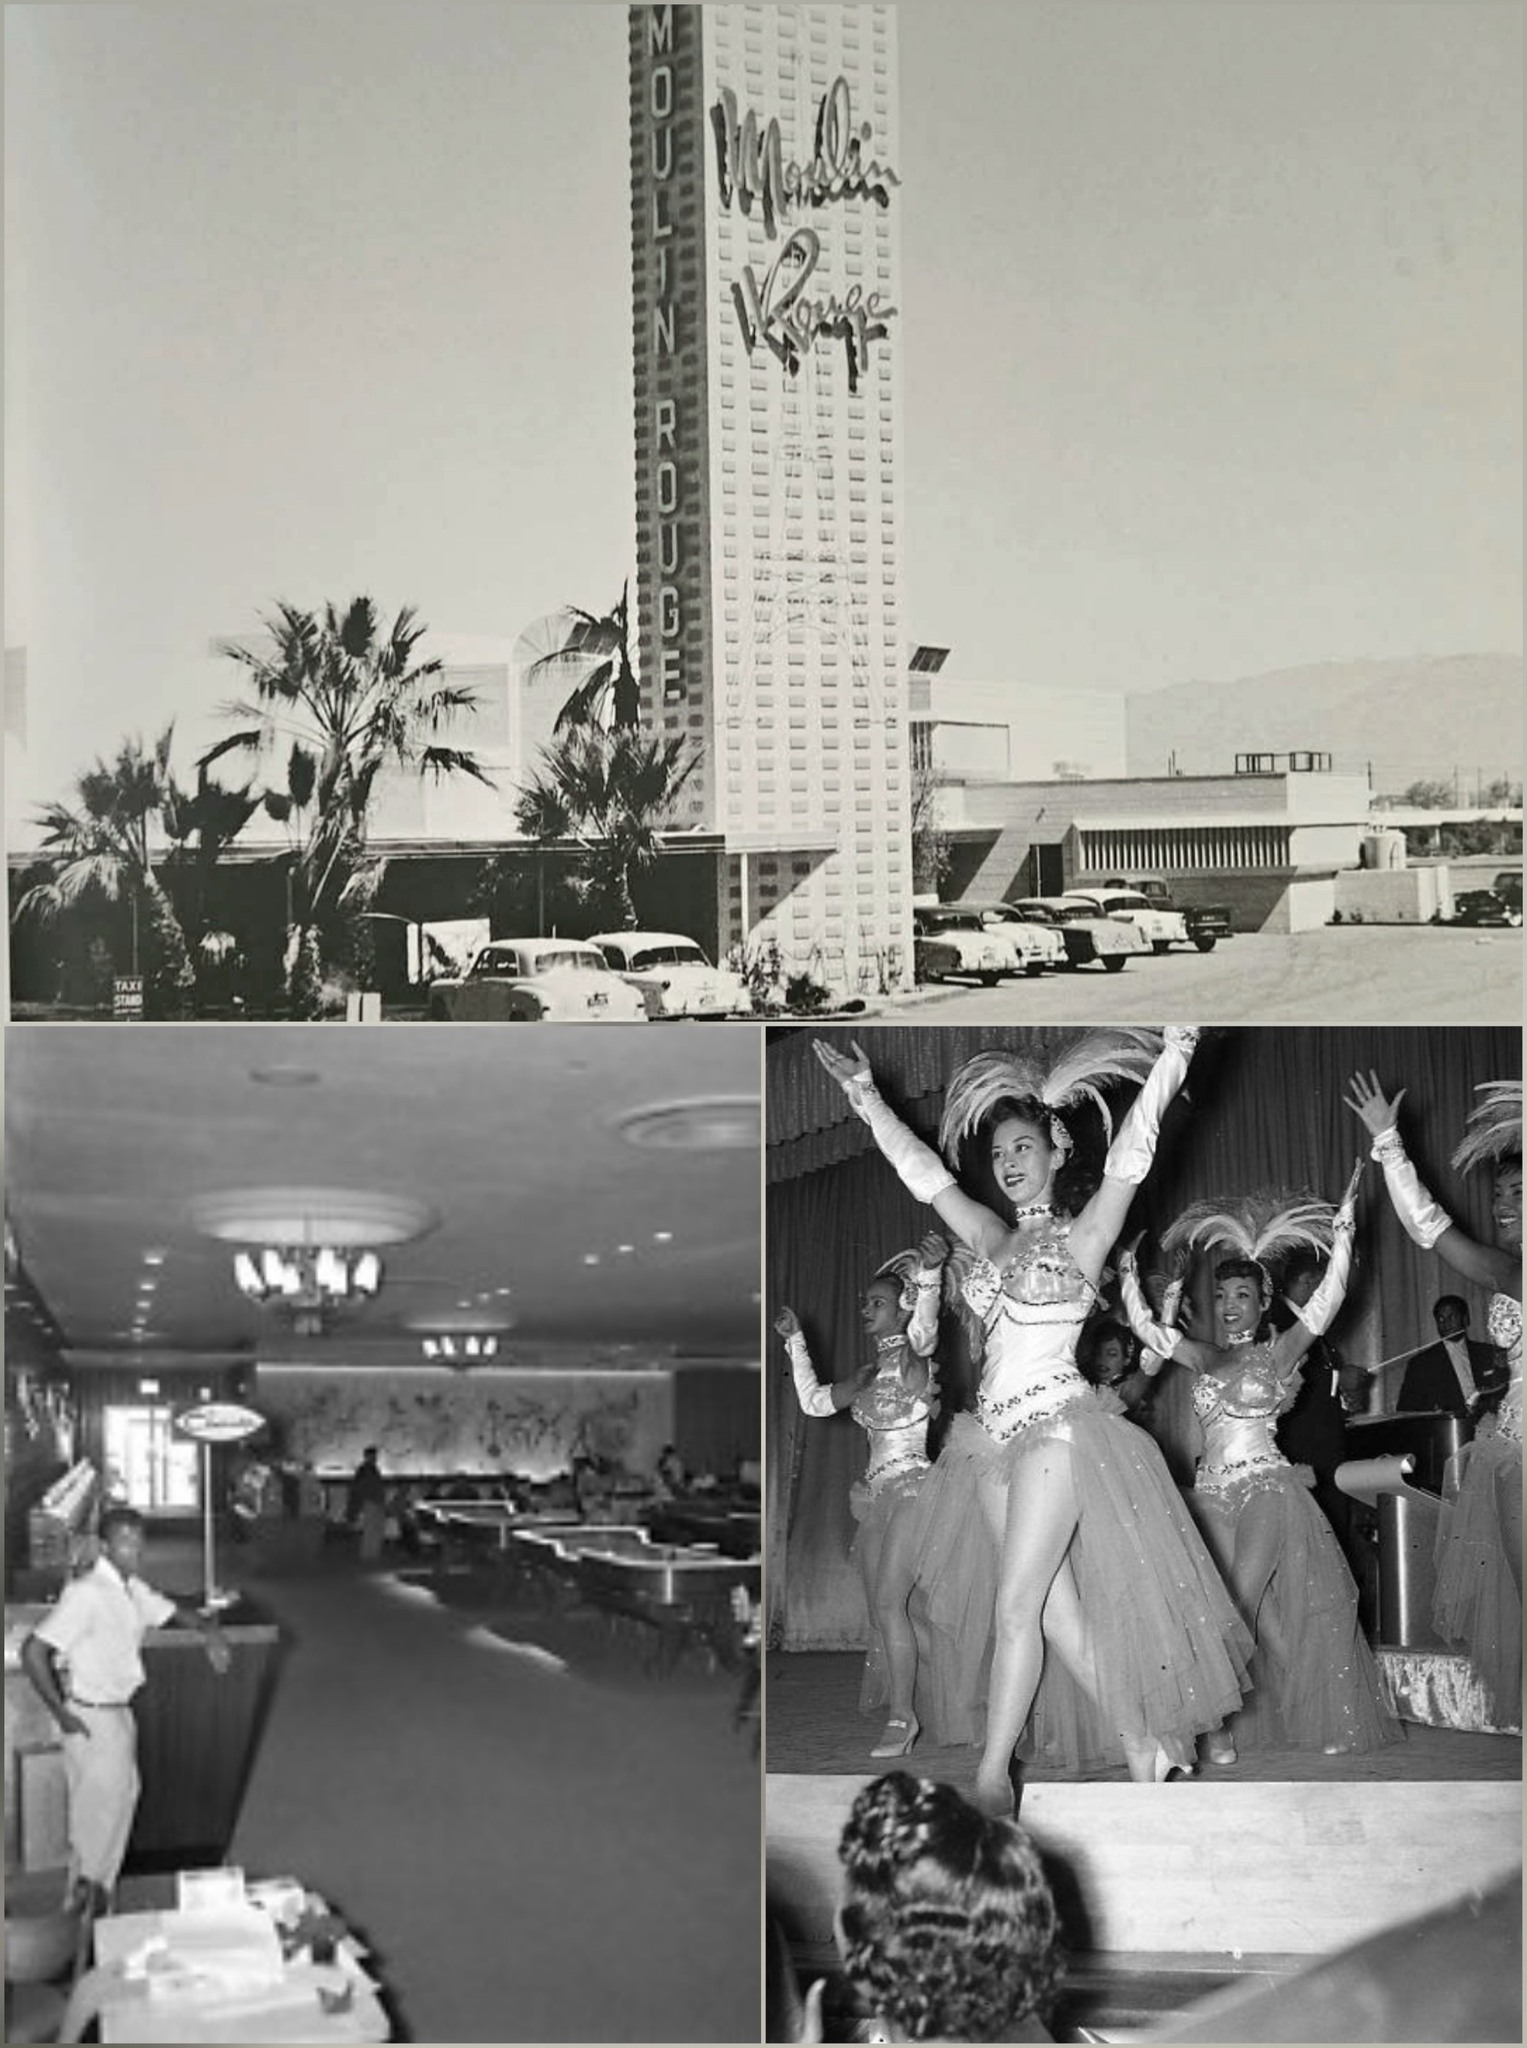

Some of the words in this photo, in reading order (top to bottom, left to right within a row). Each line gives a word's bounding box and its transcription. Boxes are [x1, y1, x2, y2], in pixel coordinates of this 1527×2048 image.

[650, 4, 676, 354] MOULIN
[715, 75, 902, 218] Moulin
[740, 227, 898, 374] Rouge
[656, 399, 681, 699] ROUGE
[115, 980, 142, 991] TAXI
